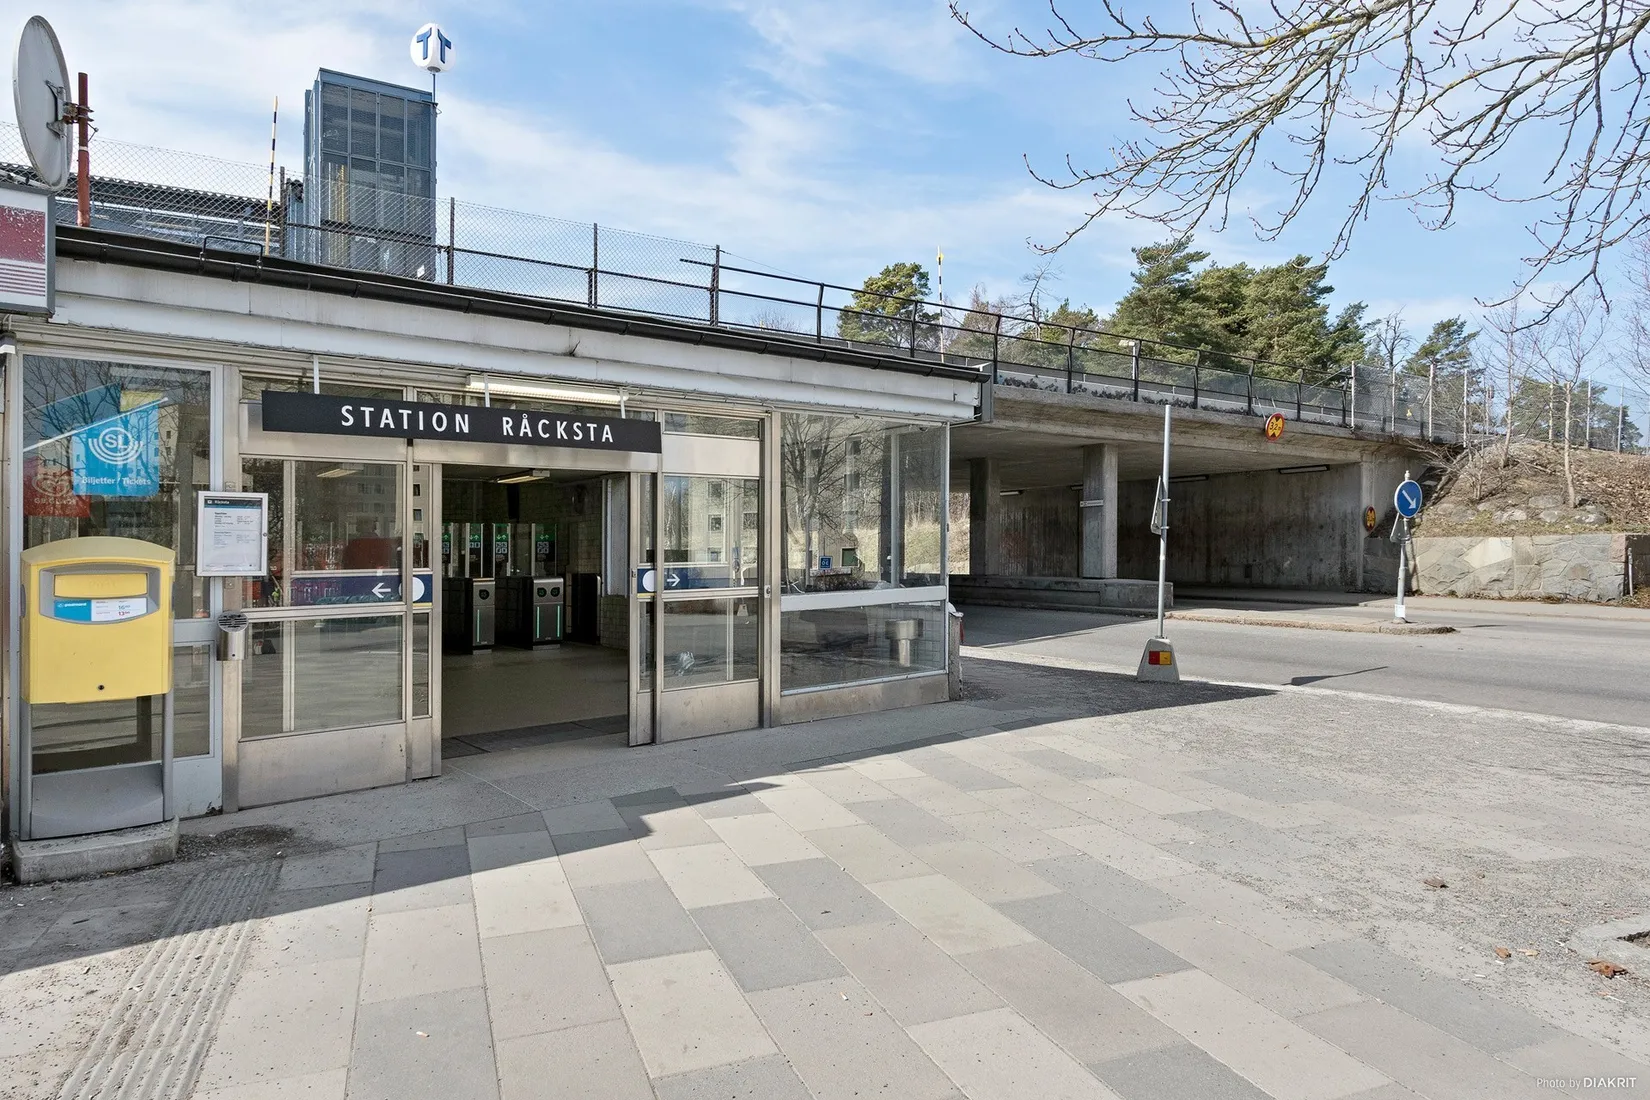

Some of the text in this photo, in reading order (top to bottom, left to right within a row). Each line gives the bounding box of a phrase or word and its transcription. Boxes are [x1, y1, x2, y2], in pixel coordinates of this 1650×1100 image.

[417, 27, 432, 60] T
[437, 28, 451, 64] T
[341, 405, 614, 443] STATION RÅCKSTA
[104, 433, 128, 449] SL
[82, 476, 116, 485] Biljetter
[122, 478, 151, 486] Tickets
